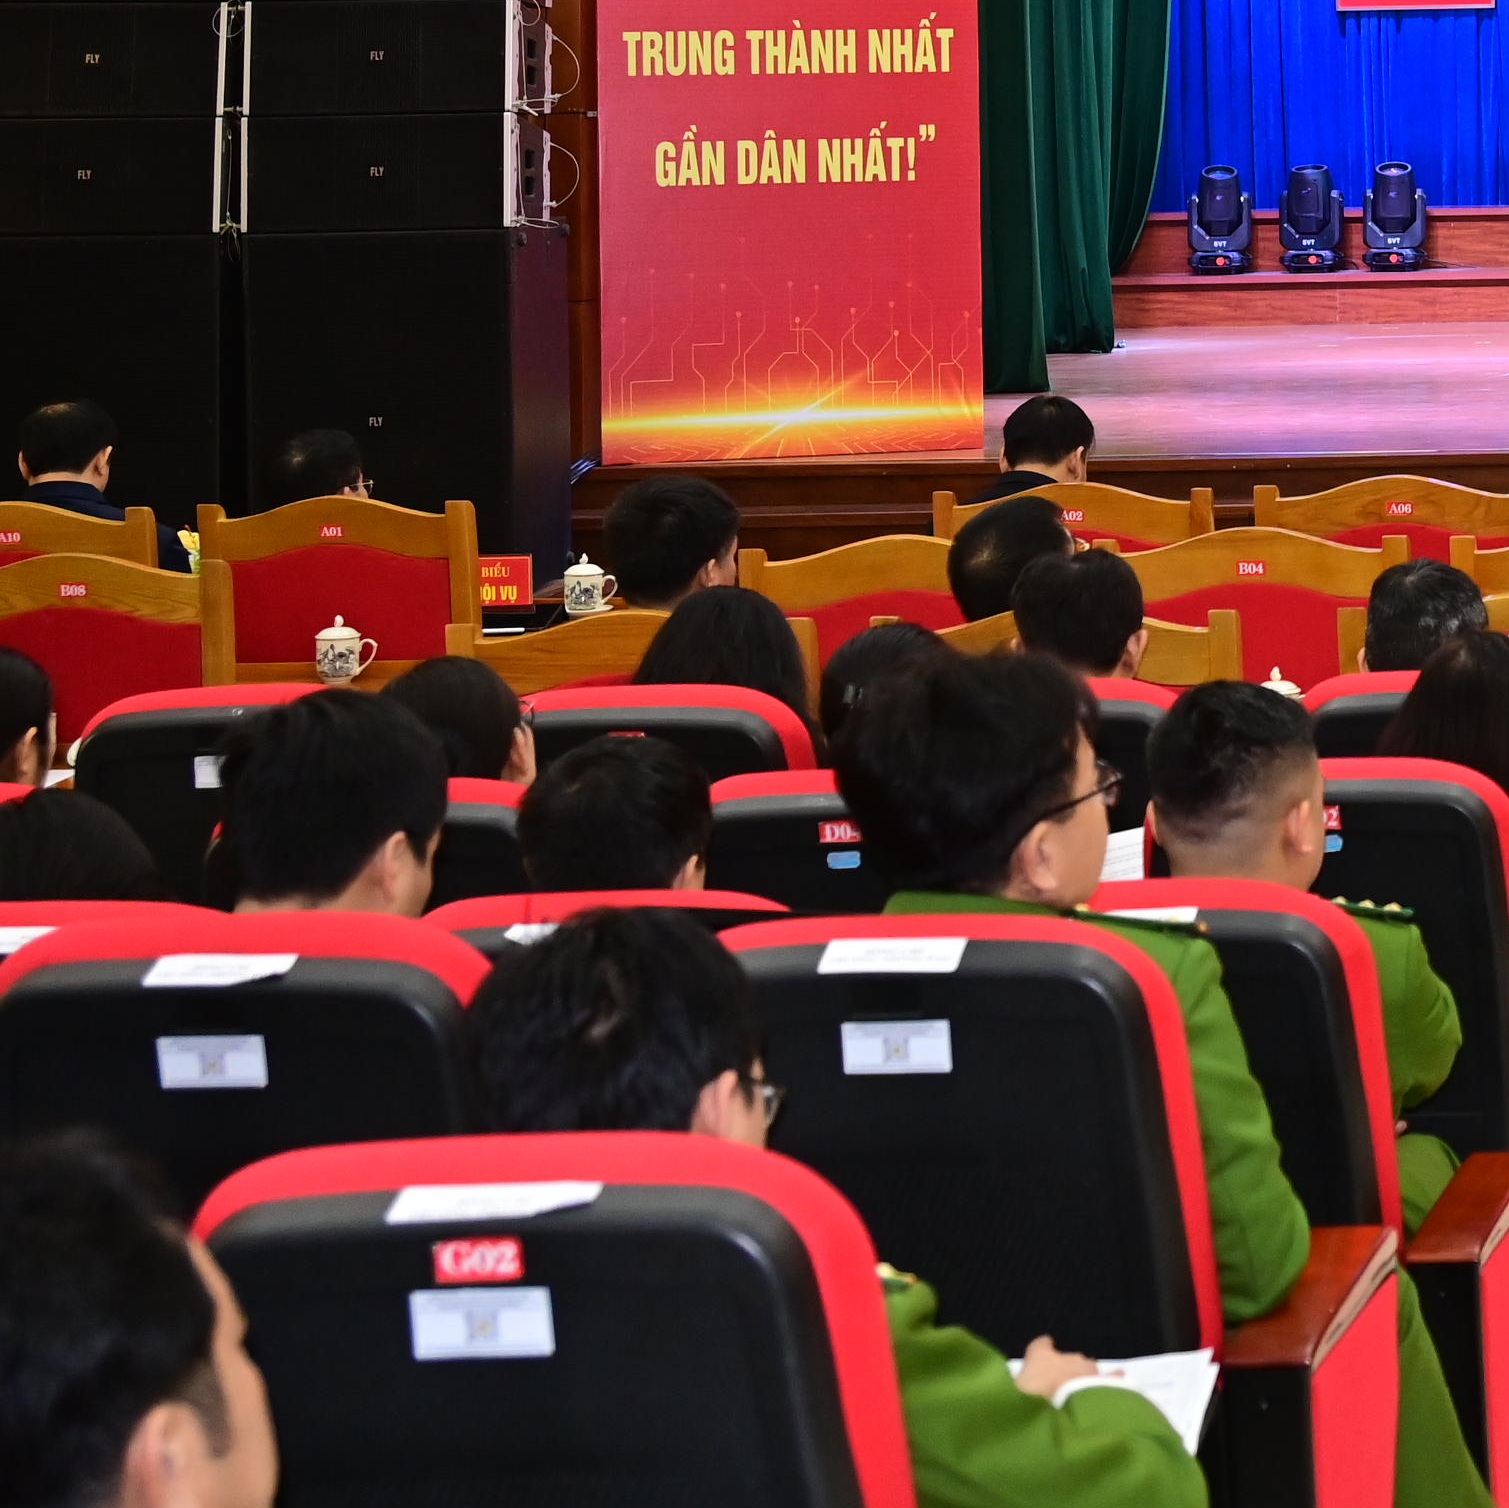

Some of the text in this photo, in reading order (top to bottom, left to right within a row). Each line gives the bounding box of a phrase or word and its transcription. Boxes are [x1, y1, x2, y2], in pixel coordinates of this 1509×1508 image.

[86, 54, 99, 63] FLY
[369, 417, 382, 426] FLY
[1388, 503, 1413, 515] A06
[1061, 510, 1084, 521] A02
[321, 527, 343, 537] A01
[482, 563, 510, 579] BIỂU
[1238, 562, 1264, 574] B04
[60, 584, 87, 598] B08
[499, 586, 519, 602] VỤ
[437, 1242, 519, 1276] G02
